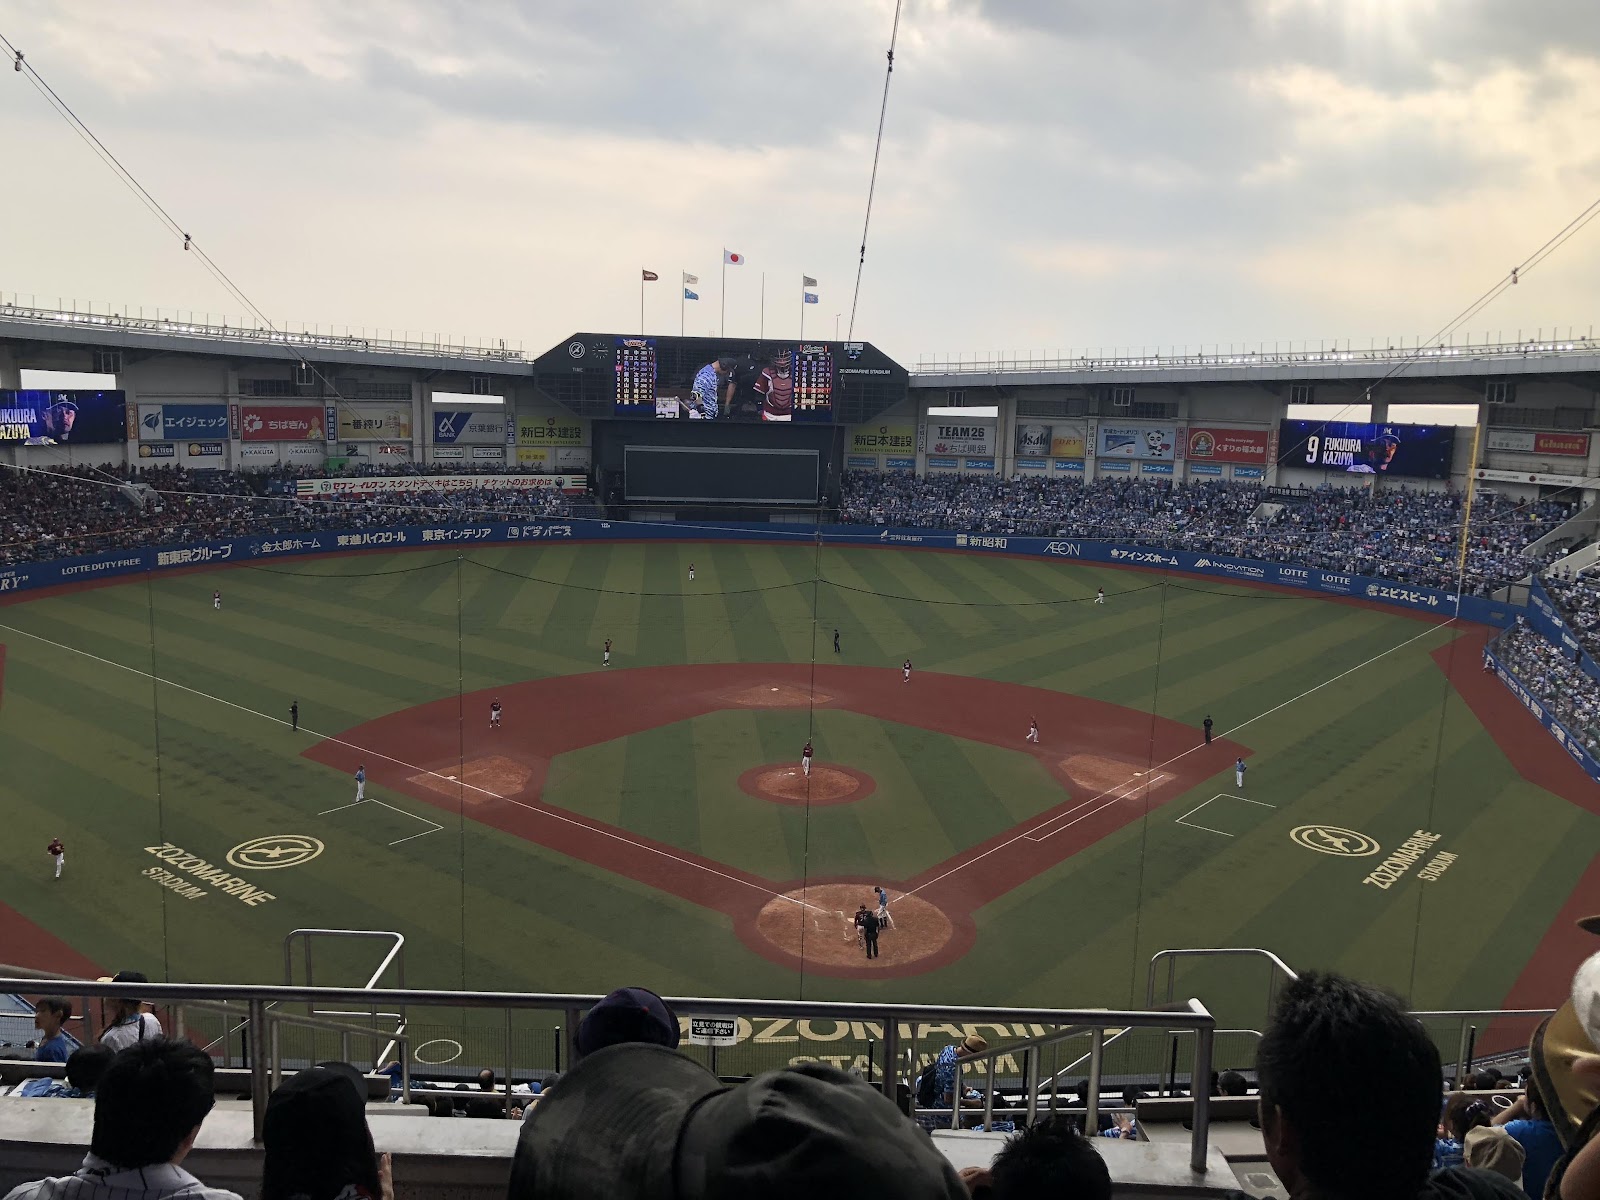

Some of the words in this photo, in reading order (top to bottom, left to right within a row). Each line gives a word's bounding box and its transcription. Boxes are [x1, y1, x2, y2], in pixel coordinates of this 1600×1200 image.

[165, 416, 228, 428] エイジェック
[268, 420, 308, 430] ちばぎん
[342, 419, 383, 430] 一番搾り
[469, 424, 503, 433] 京葉銀行
[521, 427, 581, 439] 新日本建設
[1020, 433, 1049, 446] Asahi
[854, 435, 912, 447] 新日本建設
[1324, 437, 1361, 452] FUKUURA
[950, 444, 986, 454] ちば興銀
[1306, 435, 1320, 464] 9
[1322, 451, 1354, 466] KAZUYA
[337, 531, 407, 547] 東進ハイスクール
[422, 528, 492, 542] 東京インテリア
[969, 535, 1007, 549] 新昭和
[261, 537, 321, 554] 金太郎ホーム
[157, 544, 233, 566] 新東京グループ
[1119, 549, 1179, 566] アインズホーム
[61, 566, 91, 575] LOTTE
[91, 561, 116, 571] DUTY
[117, 557, 142, 567] FREE
[1279, 567, 1309, 579] LOTTE
[1321, 574, 1351, 585] LOTTE
[1362, 829, 1442, 890] ZOZOMARINE
[1417, 850, 1459, 882] STADIUM
[144, 842, 277, 907] ZOZOMARINE
[141, 866, 208, 900] STADIUM
